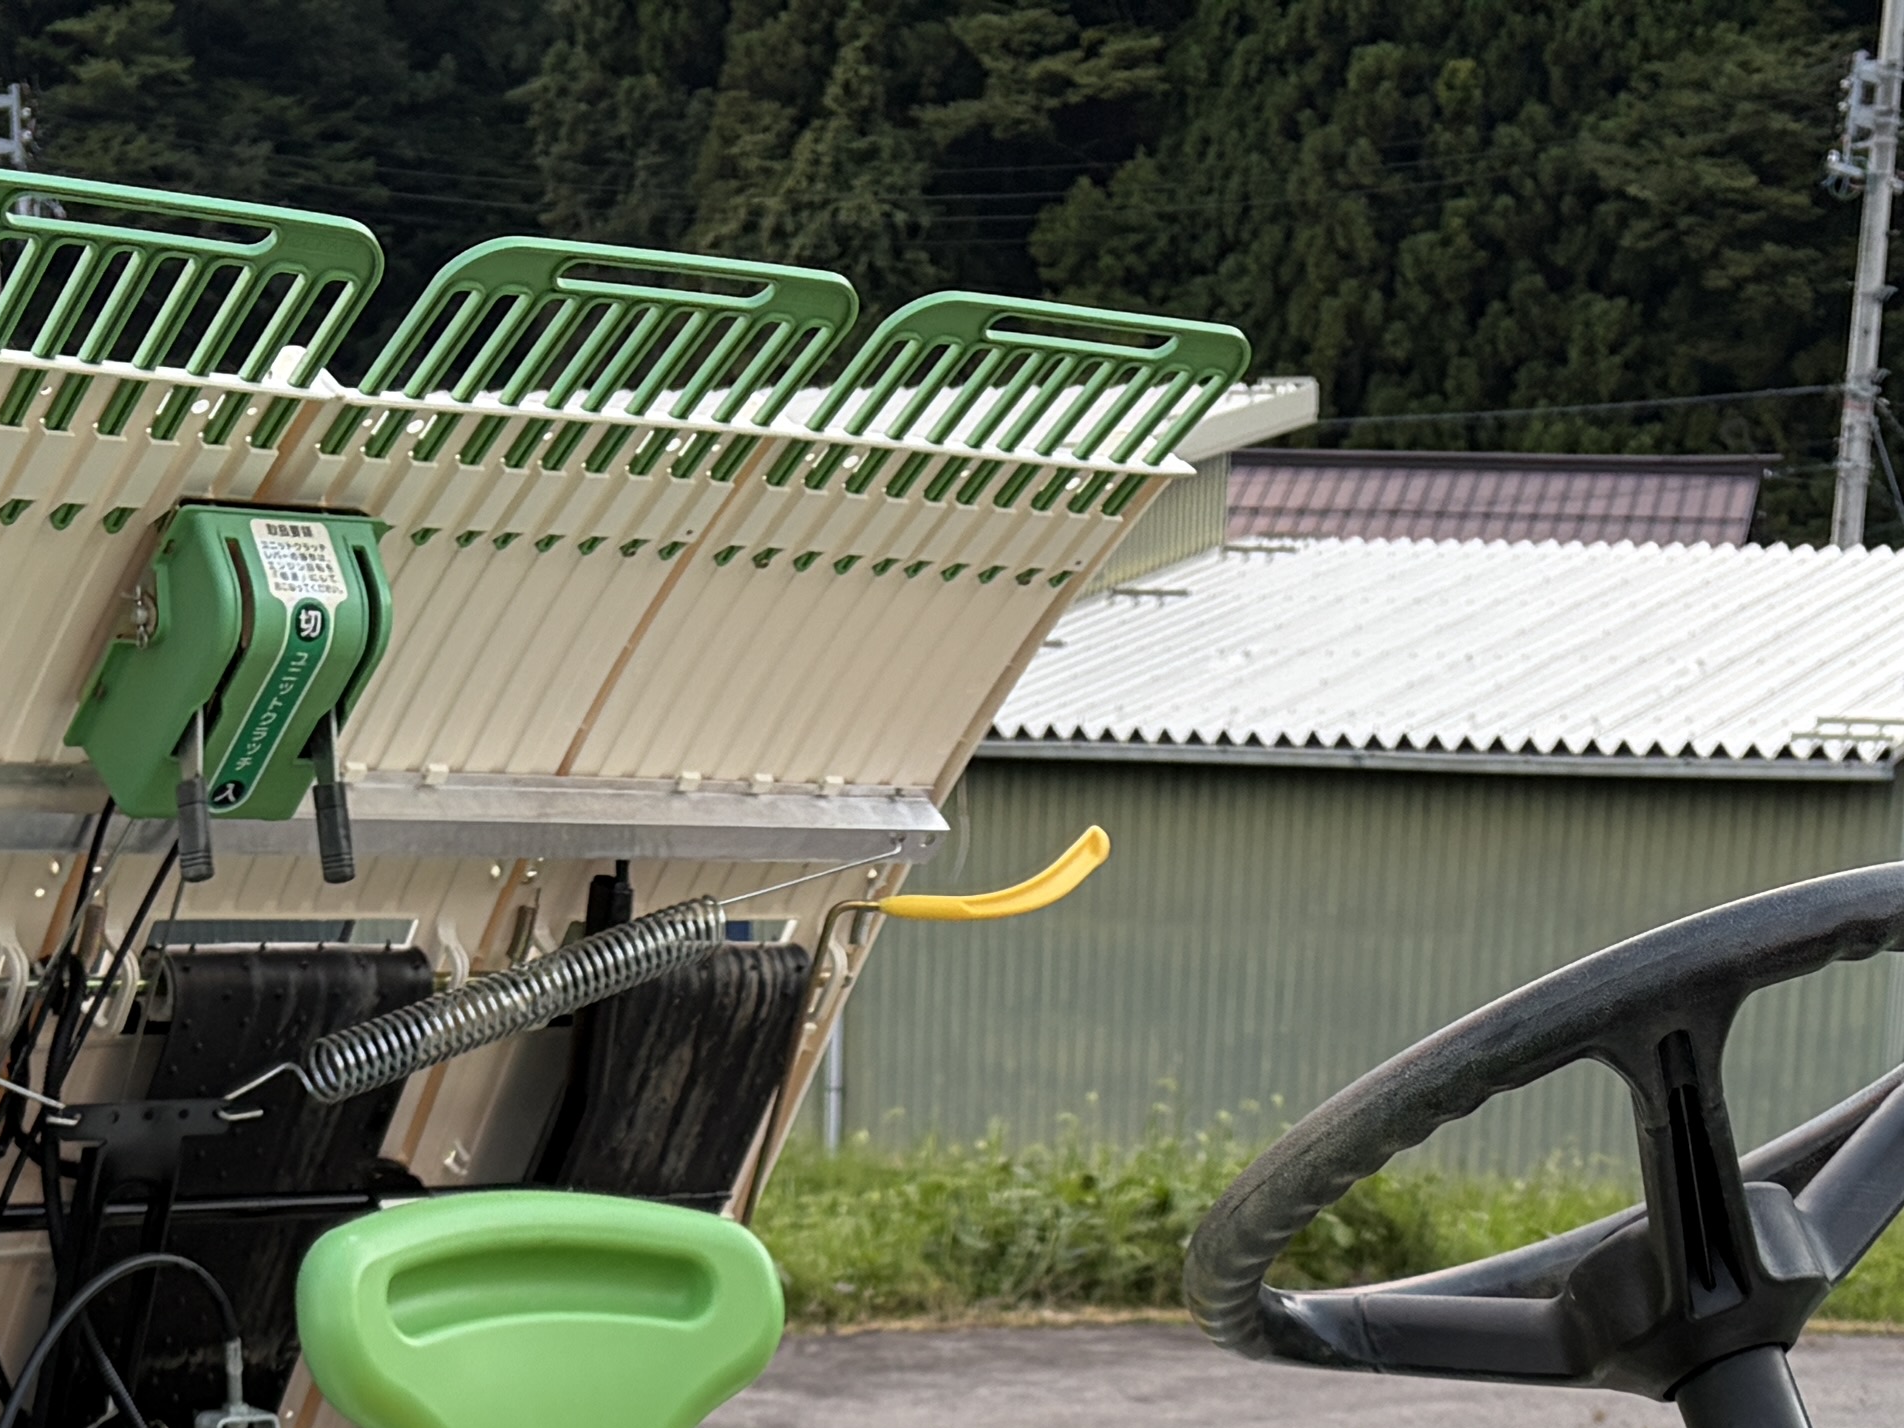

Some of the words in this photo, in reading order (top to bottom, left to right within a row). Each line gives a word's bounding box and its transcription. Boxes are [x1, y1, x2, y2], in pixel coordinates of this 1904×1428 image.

[298, 608, 322, 639] 切
[234, 651, 309, 772] ユニットクラッチ
[213, 782, 236, 803] 入
